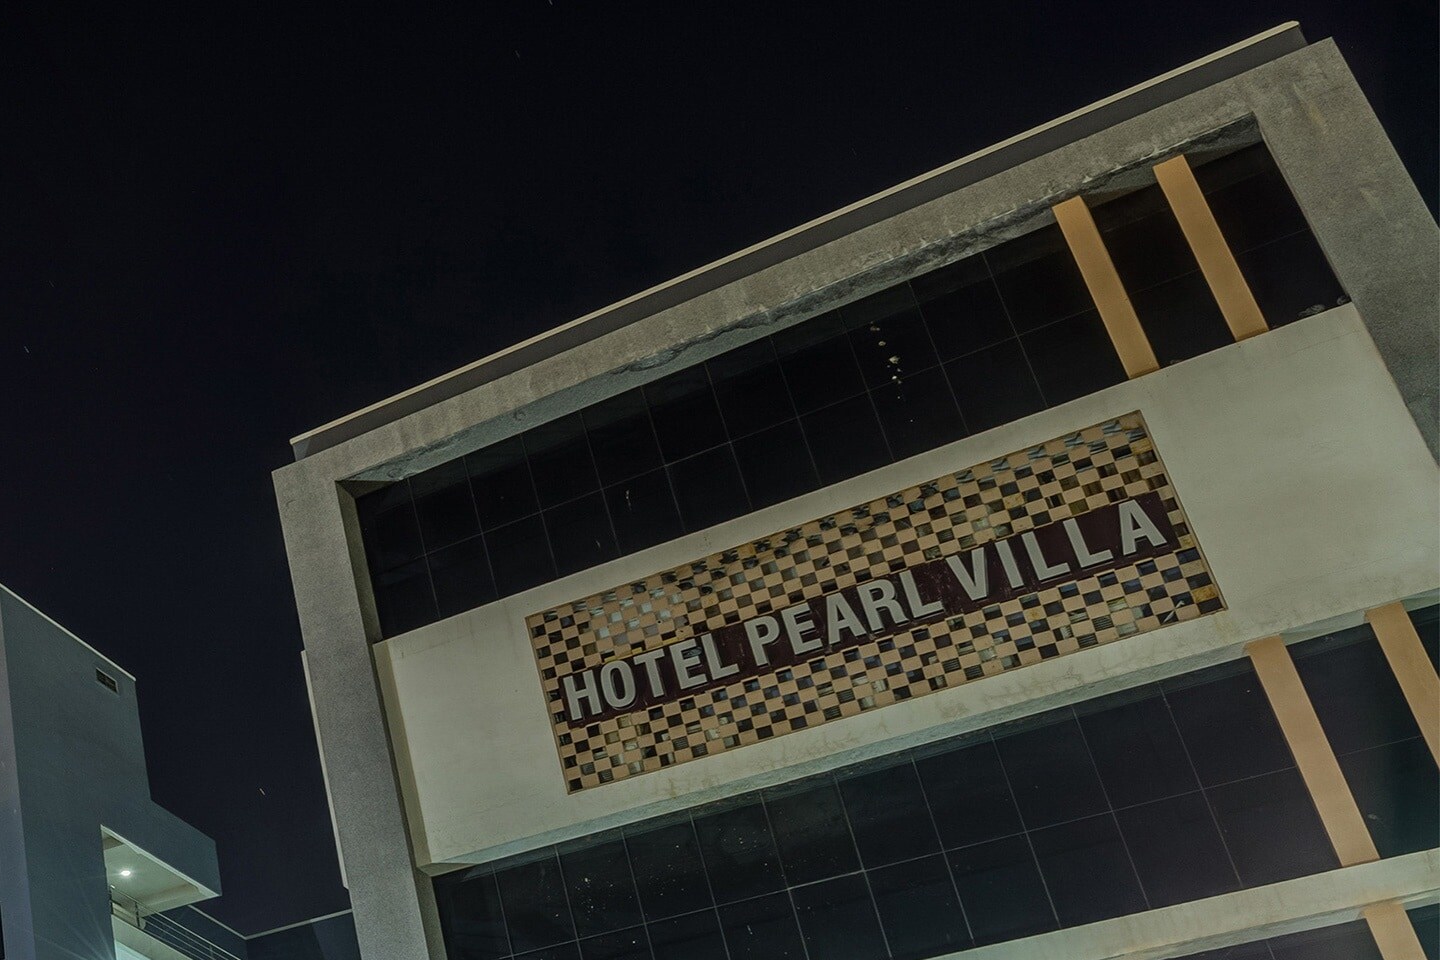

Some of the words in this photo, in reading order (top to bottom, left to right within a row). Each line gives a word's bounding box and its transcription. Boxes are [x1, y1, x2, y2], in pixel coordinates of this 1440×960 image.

[562, 634, 738, 721] HOTEL
[744, 570, 944, 667] PEARL
[946, 498, 1168, 603] VILLA
